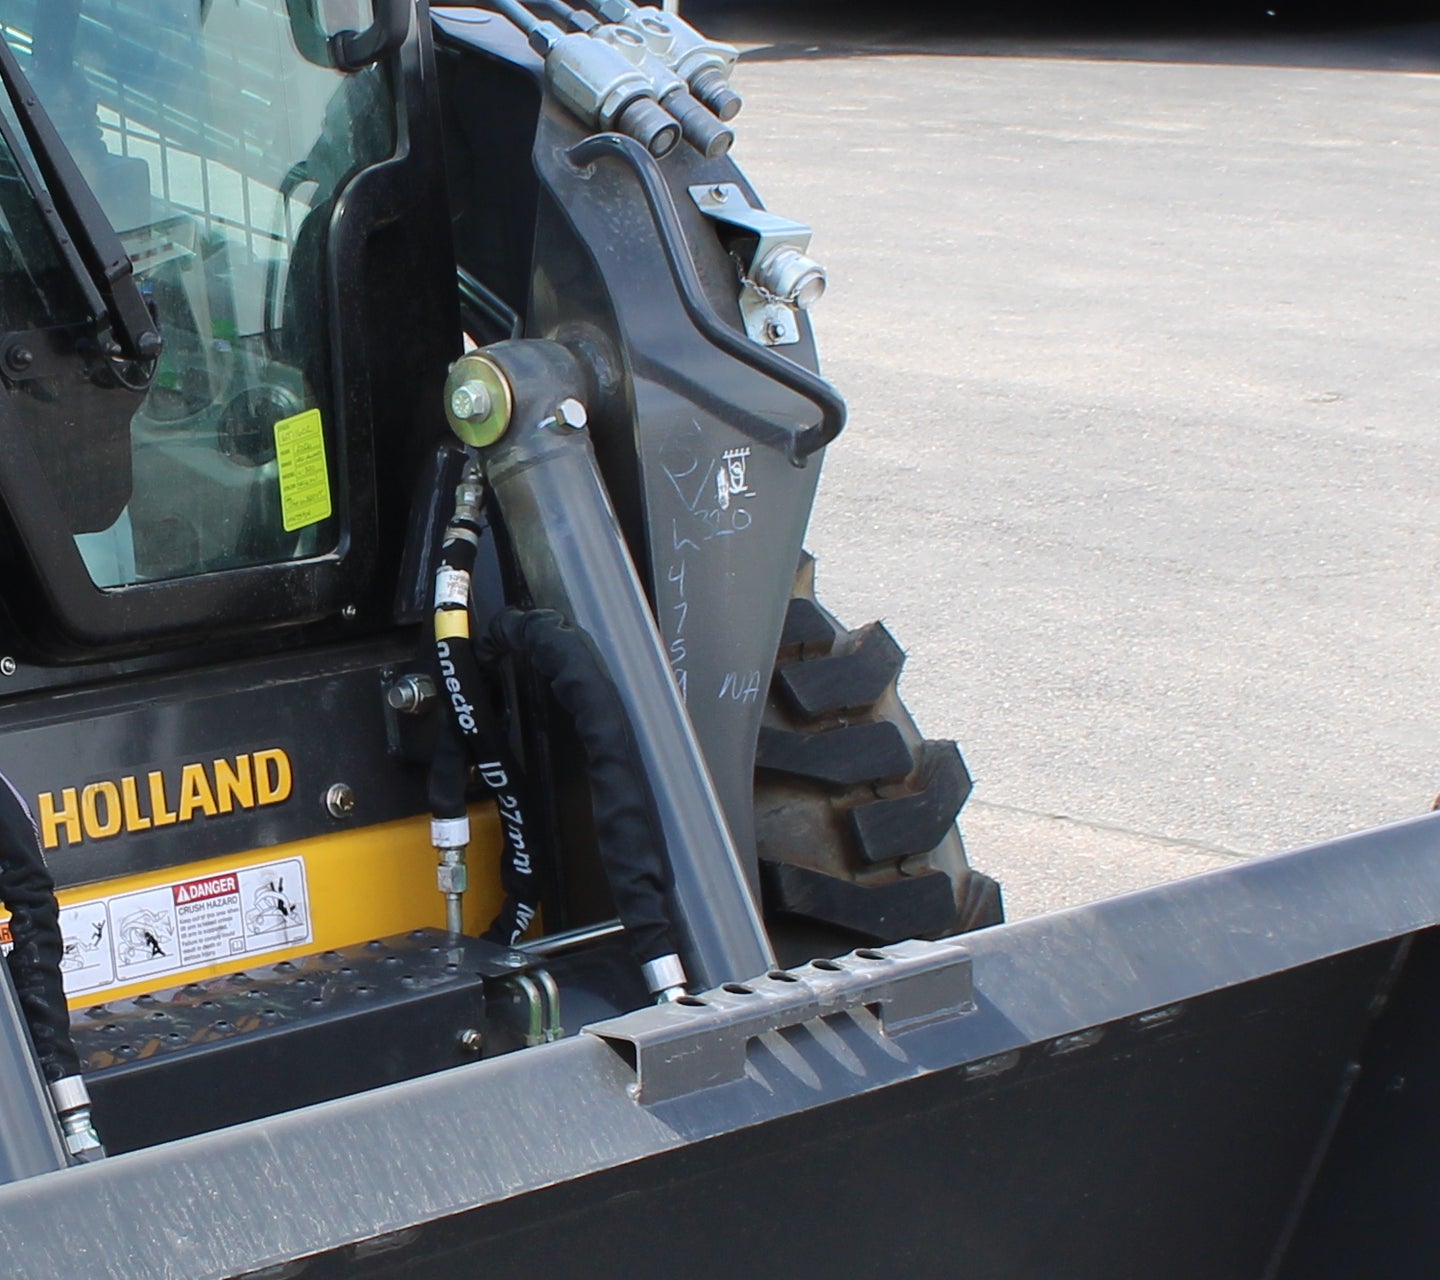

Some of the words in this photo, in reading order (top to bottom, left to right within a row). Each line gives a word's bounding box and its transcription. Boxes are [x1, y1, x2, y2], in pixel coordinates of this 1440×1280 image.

[37, 747, 293, 849] HOLLAND
[189, 877, 237, 900] DANGER
[178, 902, 206, 916] CRUSH
[206, 895, 239, 910] HAZARD
